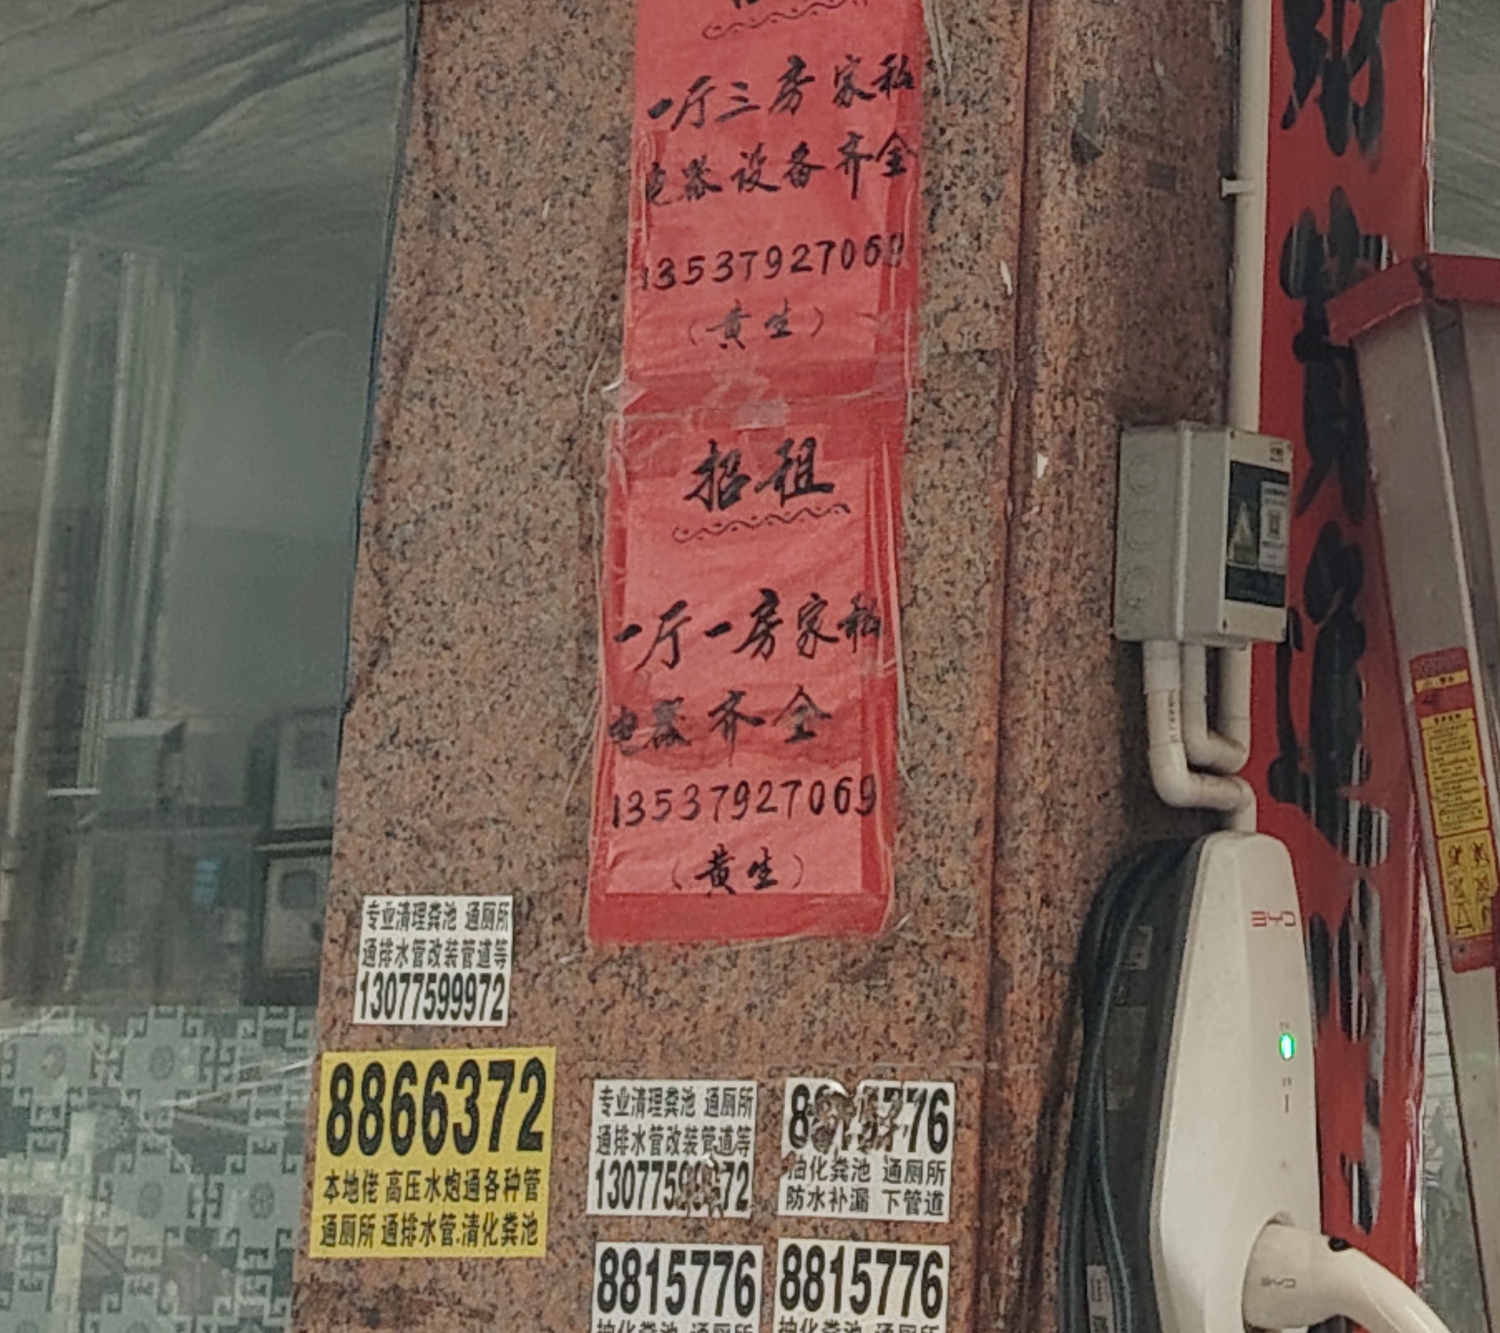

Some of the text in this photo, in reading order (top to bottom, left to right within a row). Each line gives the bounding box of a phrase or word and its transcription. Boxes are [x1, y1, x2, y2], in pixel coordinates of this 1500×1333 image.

[684, 436, 836, 512] 招租
[612, 773, 877, 829] 13537927069
[359, 971, 506, 1022] 13077599972
[326, 1056, 547, 1156] 8866372
[883, 1156, 947, 1187] 通厕所
[785, 1185, 946, 1217] 防水补漏 下管道
[319, 1212, 376, 1249] 通厕所
[597, 1246, 757, 1318] 8815776
[779, 1243, 944, 1319] 8815776
